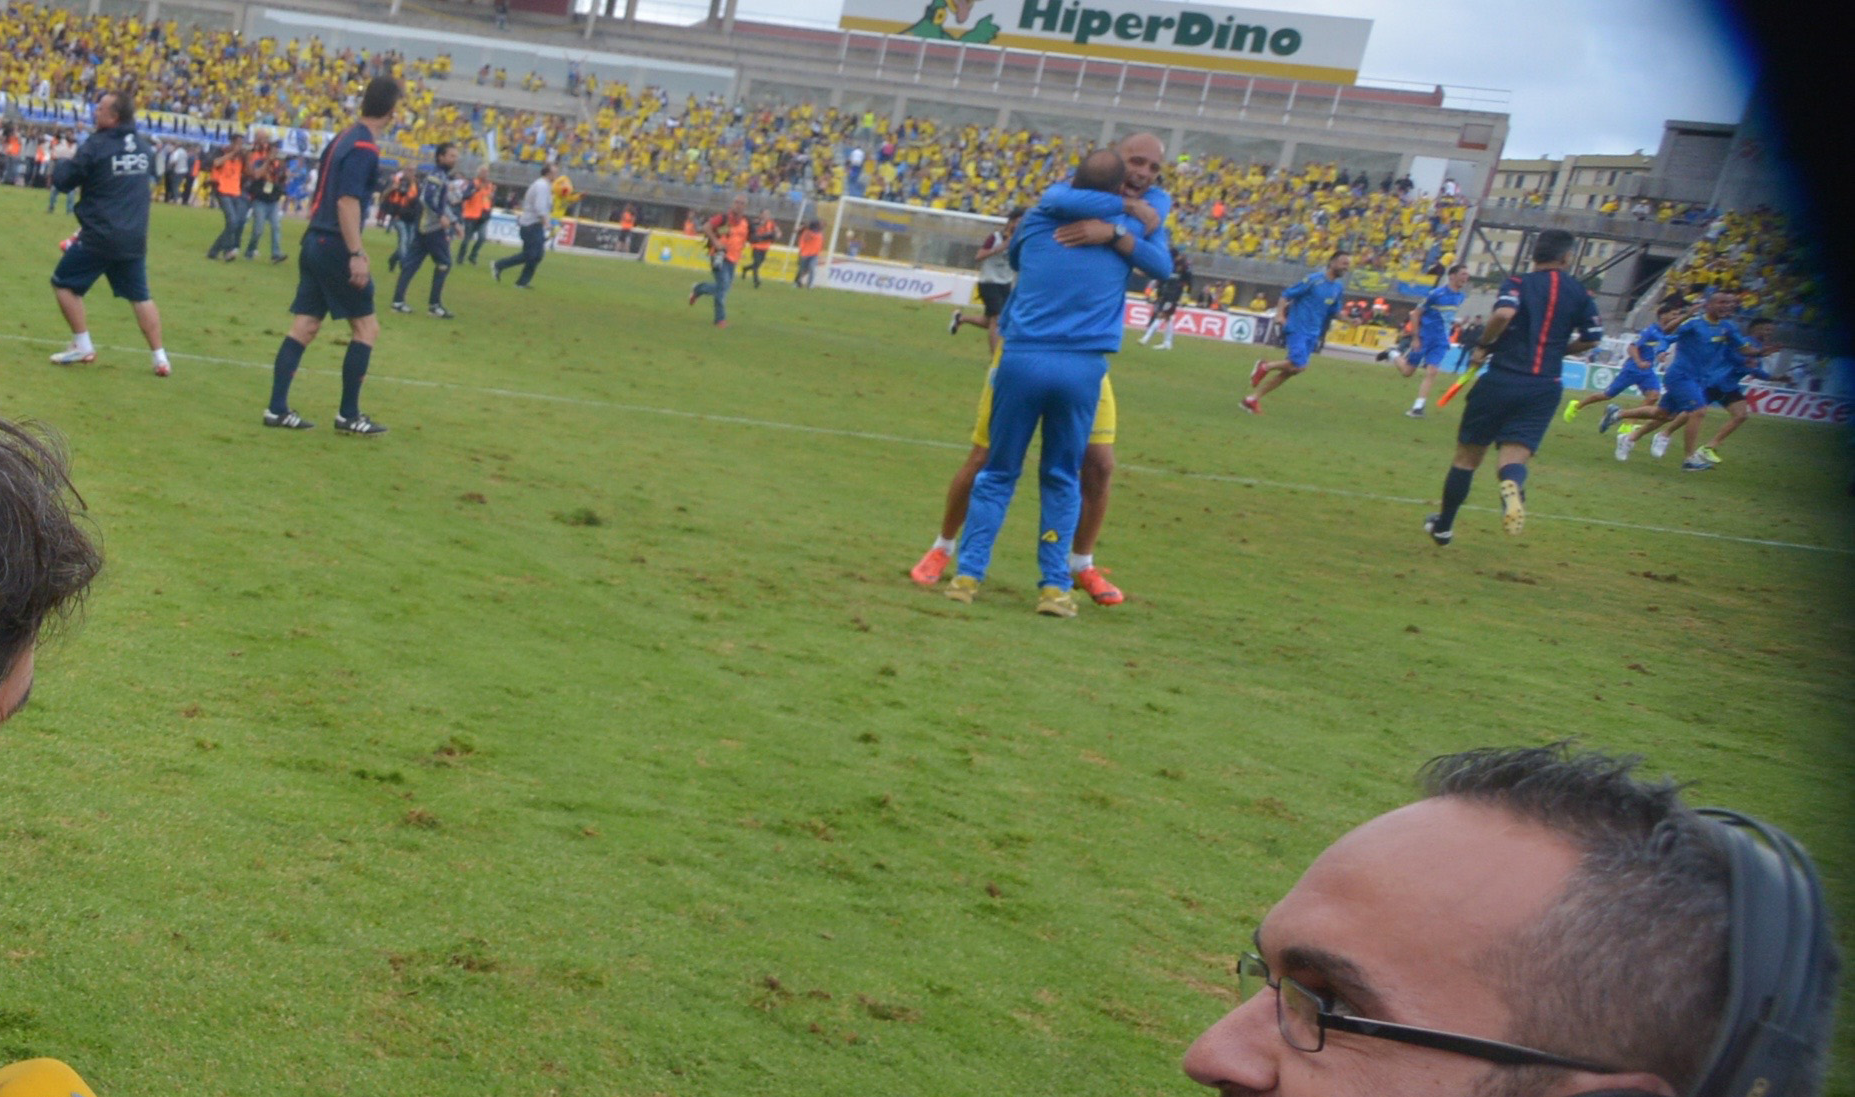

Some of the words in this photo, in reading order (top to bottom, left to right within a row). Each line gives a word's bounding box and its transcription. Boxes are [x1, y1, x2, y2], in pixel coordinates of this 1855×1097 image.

[1018, 0, 1302, 56] HiperDino
[112, 153, 149, 170] HPS
[1128, 304, 1223, 337] SAR
[1746, 388, 1850, 422] Kalise
